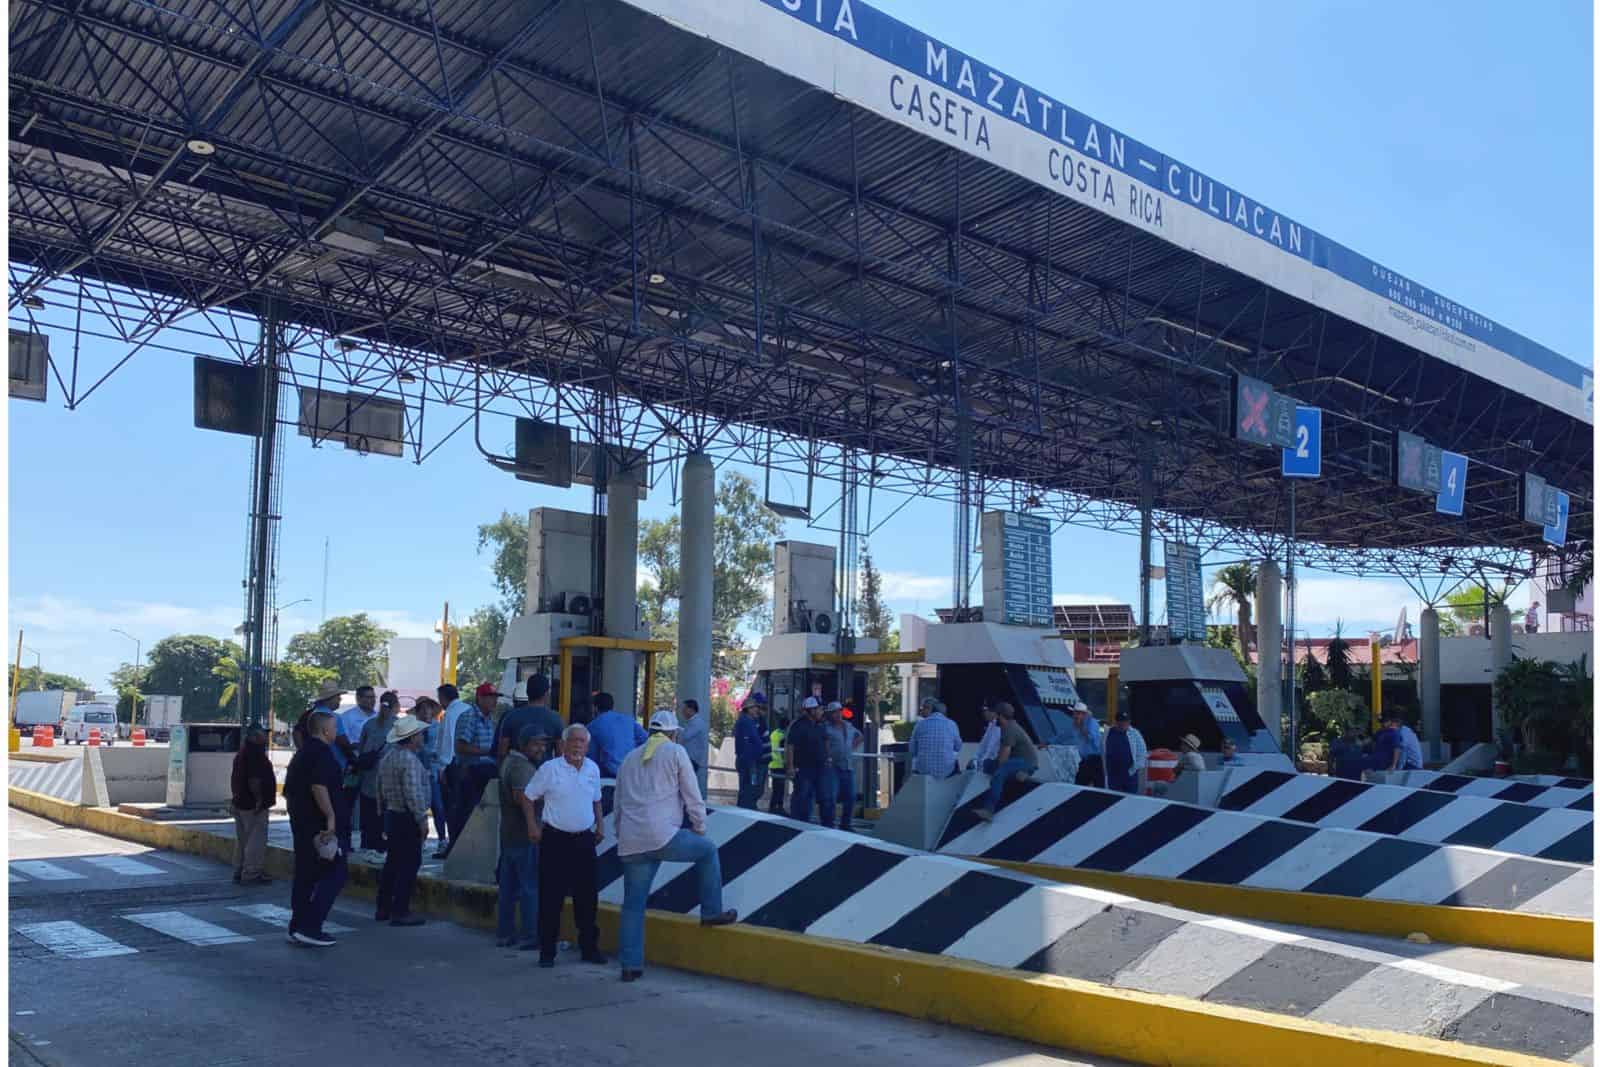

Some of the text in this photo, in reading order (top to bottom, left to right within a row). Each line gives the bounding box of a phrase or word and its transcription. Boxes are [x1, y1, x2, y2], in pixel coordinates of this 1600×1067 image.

[890, 74, 1164, 228] CASETA COSTA RICA
[925, 40, 1126, 169] MAZATLAN
[1167, 163, 1302, 253] CULIACAN
[1296, 425, 1309, 458] 2
[1447, 467, 1457, 497] 4
